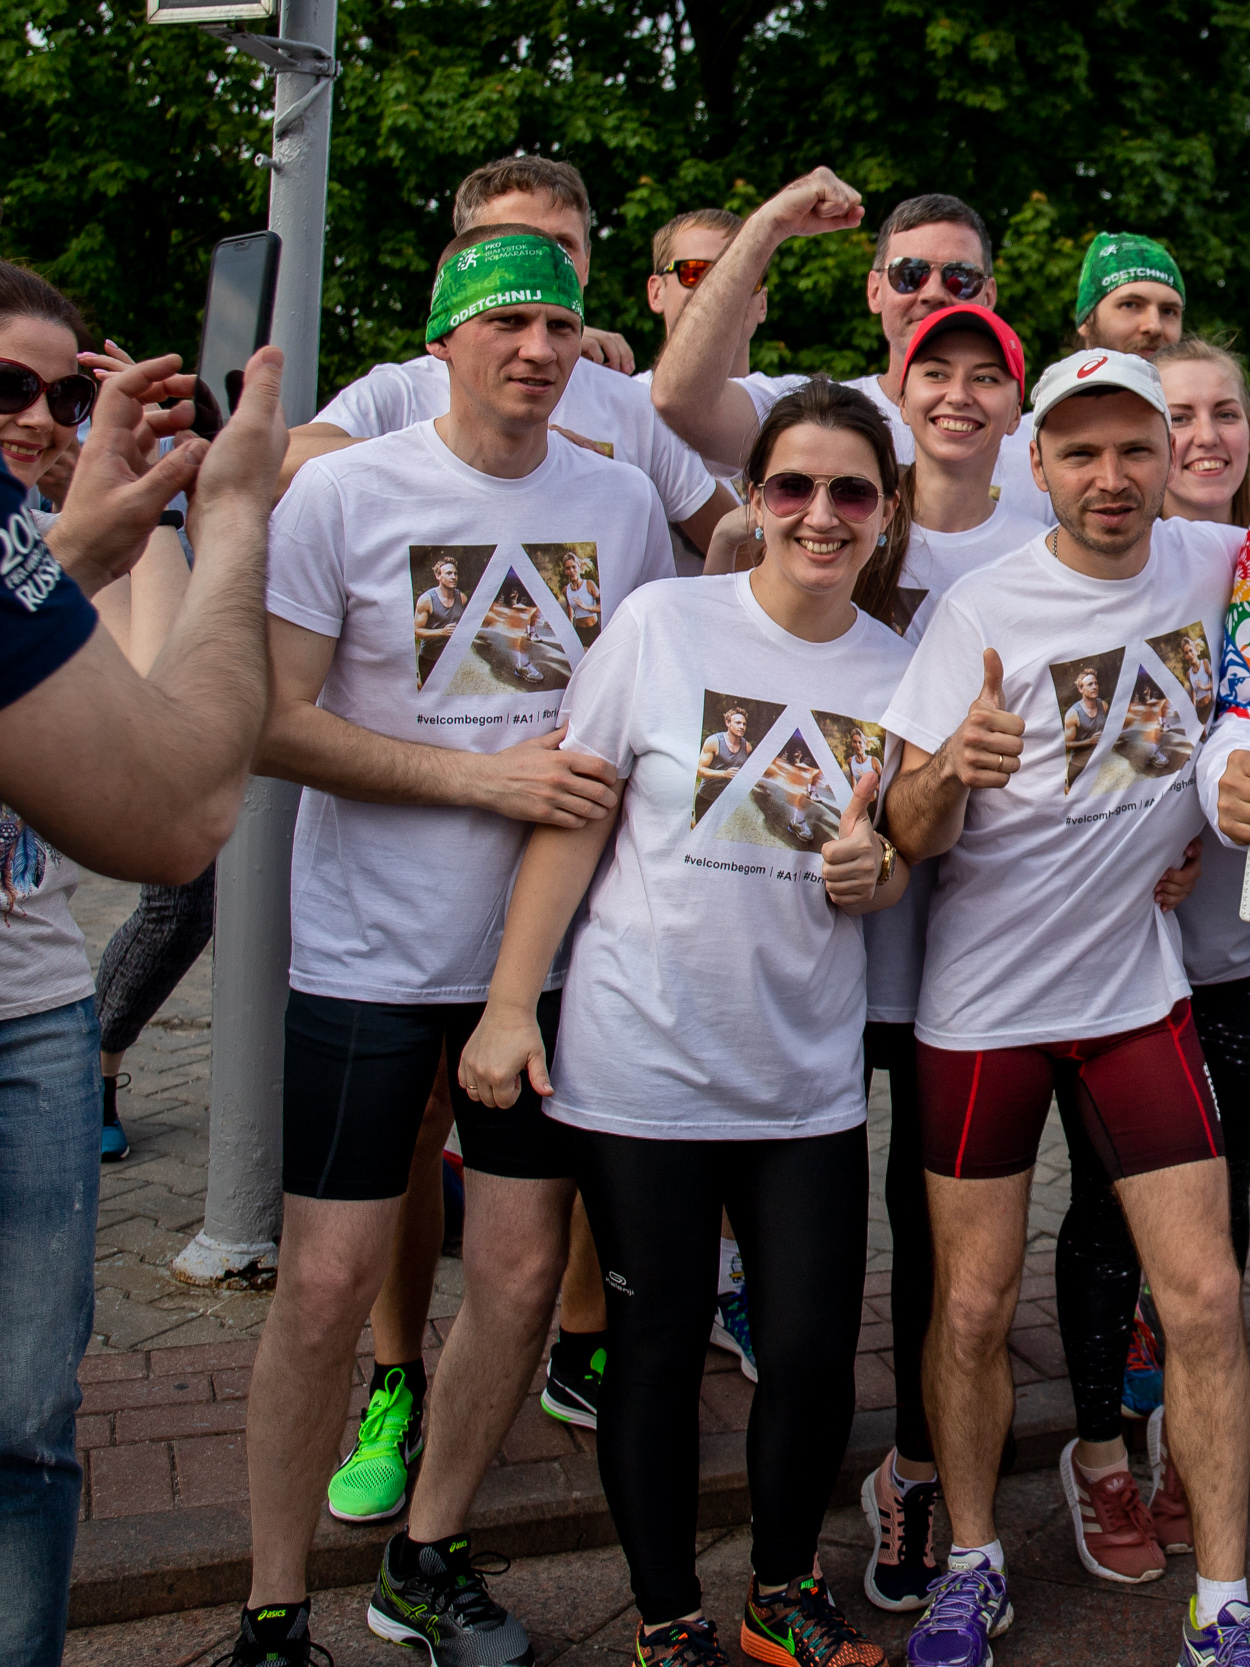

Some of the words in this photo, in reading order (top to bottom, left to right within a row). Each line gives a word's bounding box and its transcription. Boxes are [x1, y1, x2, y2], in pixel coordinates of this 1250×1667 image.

[450, 289, 541, 327] ODETCHNIJ
[416, 713, 503, 727] #velcombegom
[513, 713, 534, 725] #A1
[683, 853, 767, 876] #velcombegom
[776, 869, 798, 882] #A1
